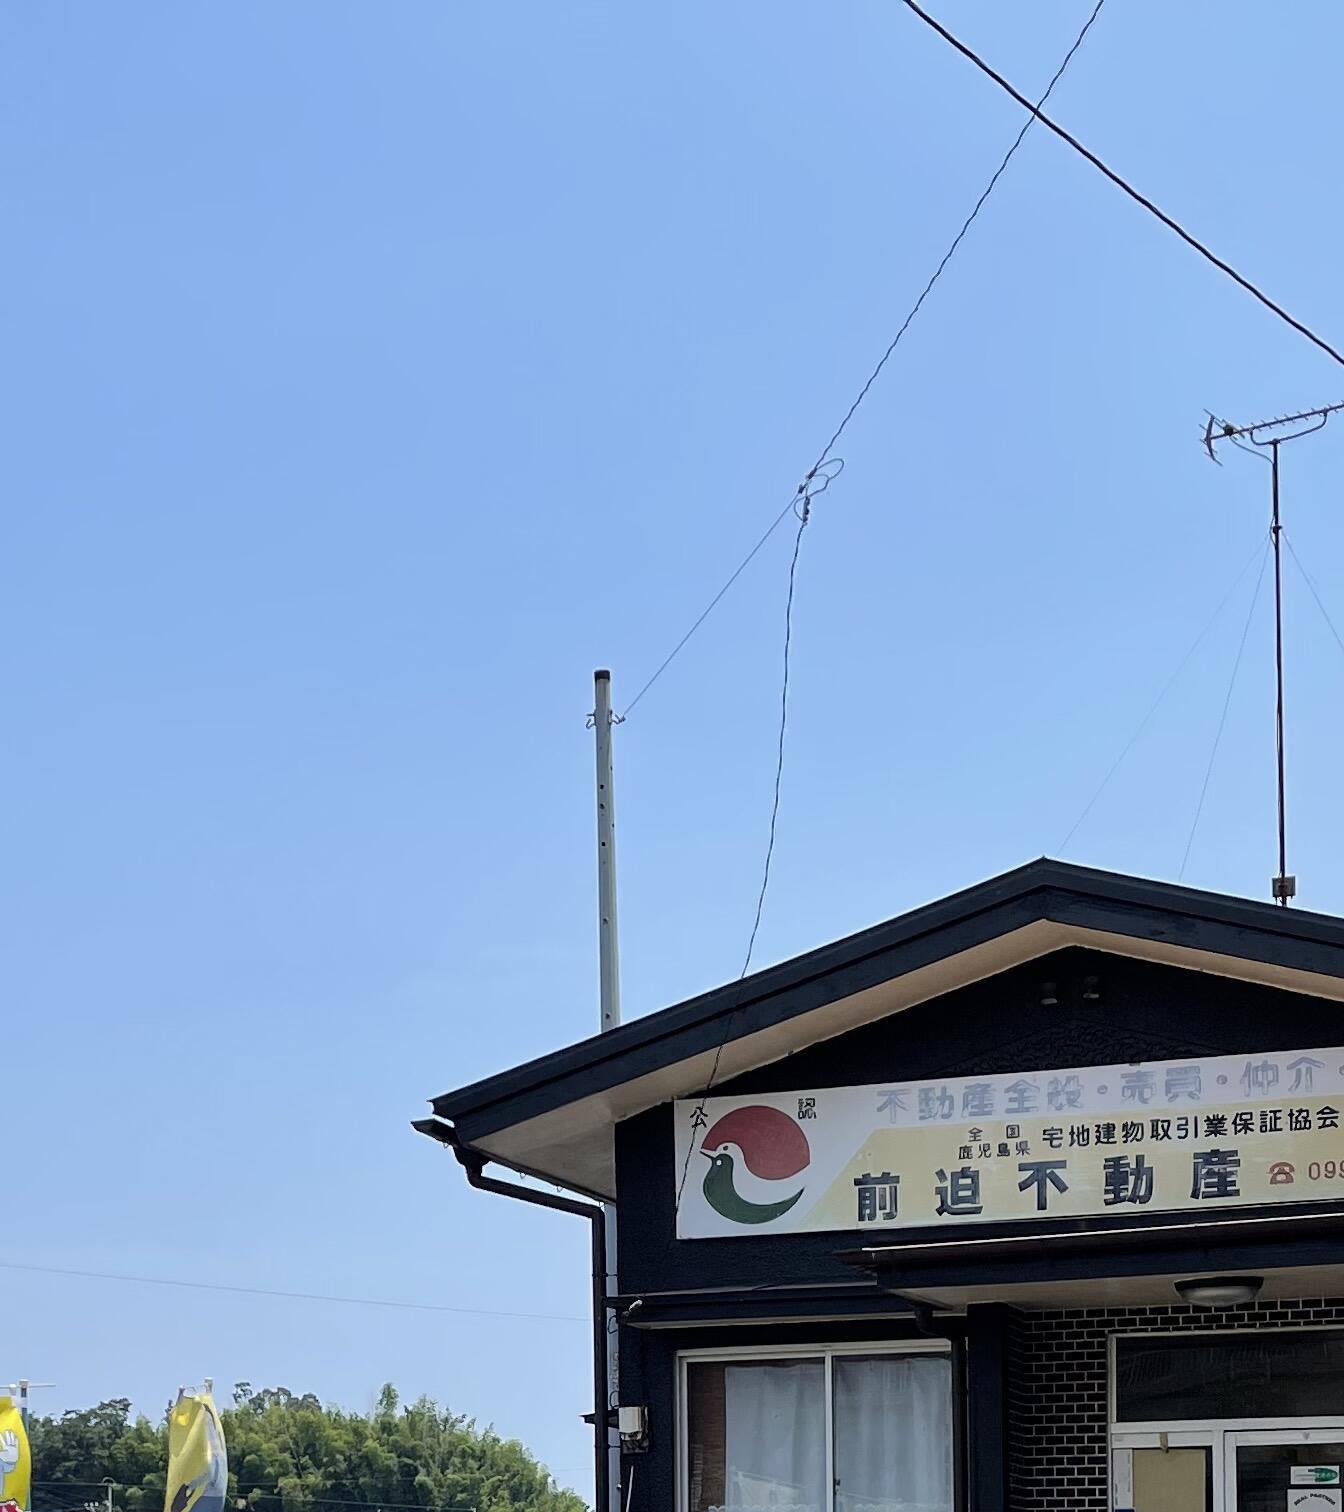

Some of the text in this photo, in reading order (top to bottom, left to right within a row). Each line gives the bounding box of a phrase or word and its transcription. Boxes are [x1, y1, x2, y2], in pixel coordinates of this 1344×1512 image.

[967, 1123, 1021, 1143] 全国
[958, 1140, 1031, 1160] 鹿児島県
[853, 1149, 1242, 1222] 前迫不動産
